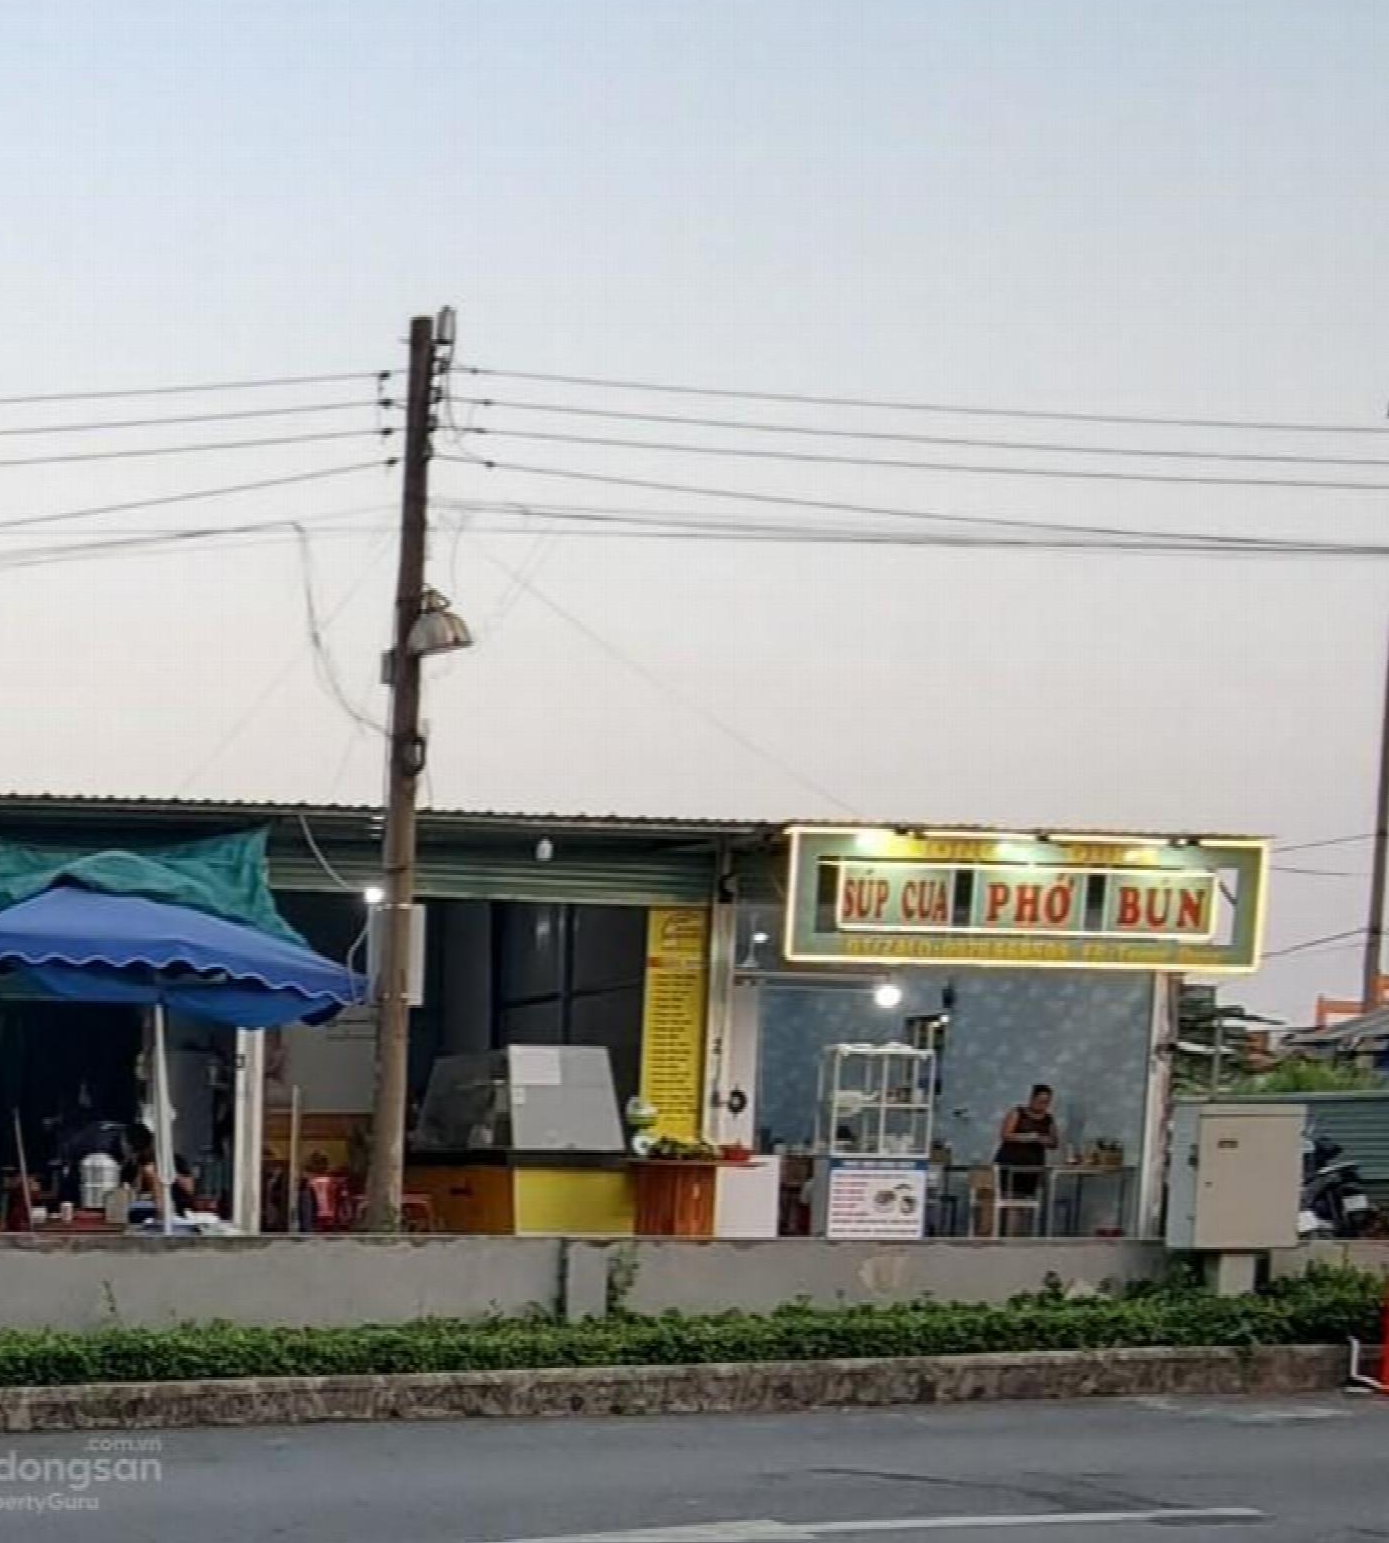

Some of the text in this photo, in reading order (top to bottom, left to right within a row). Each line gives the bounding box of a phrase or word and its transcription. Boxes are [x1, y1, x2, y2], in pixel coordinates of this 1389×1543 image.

[842, 869, 949, 921] SÚP CUA
[986, 872, 1075, 924] PHỞ
[1117, 879, 1206, 929] BÚN
